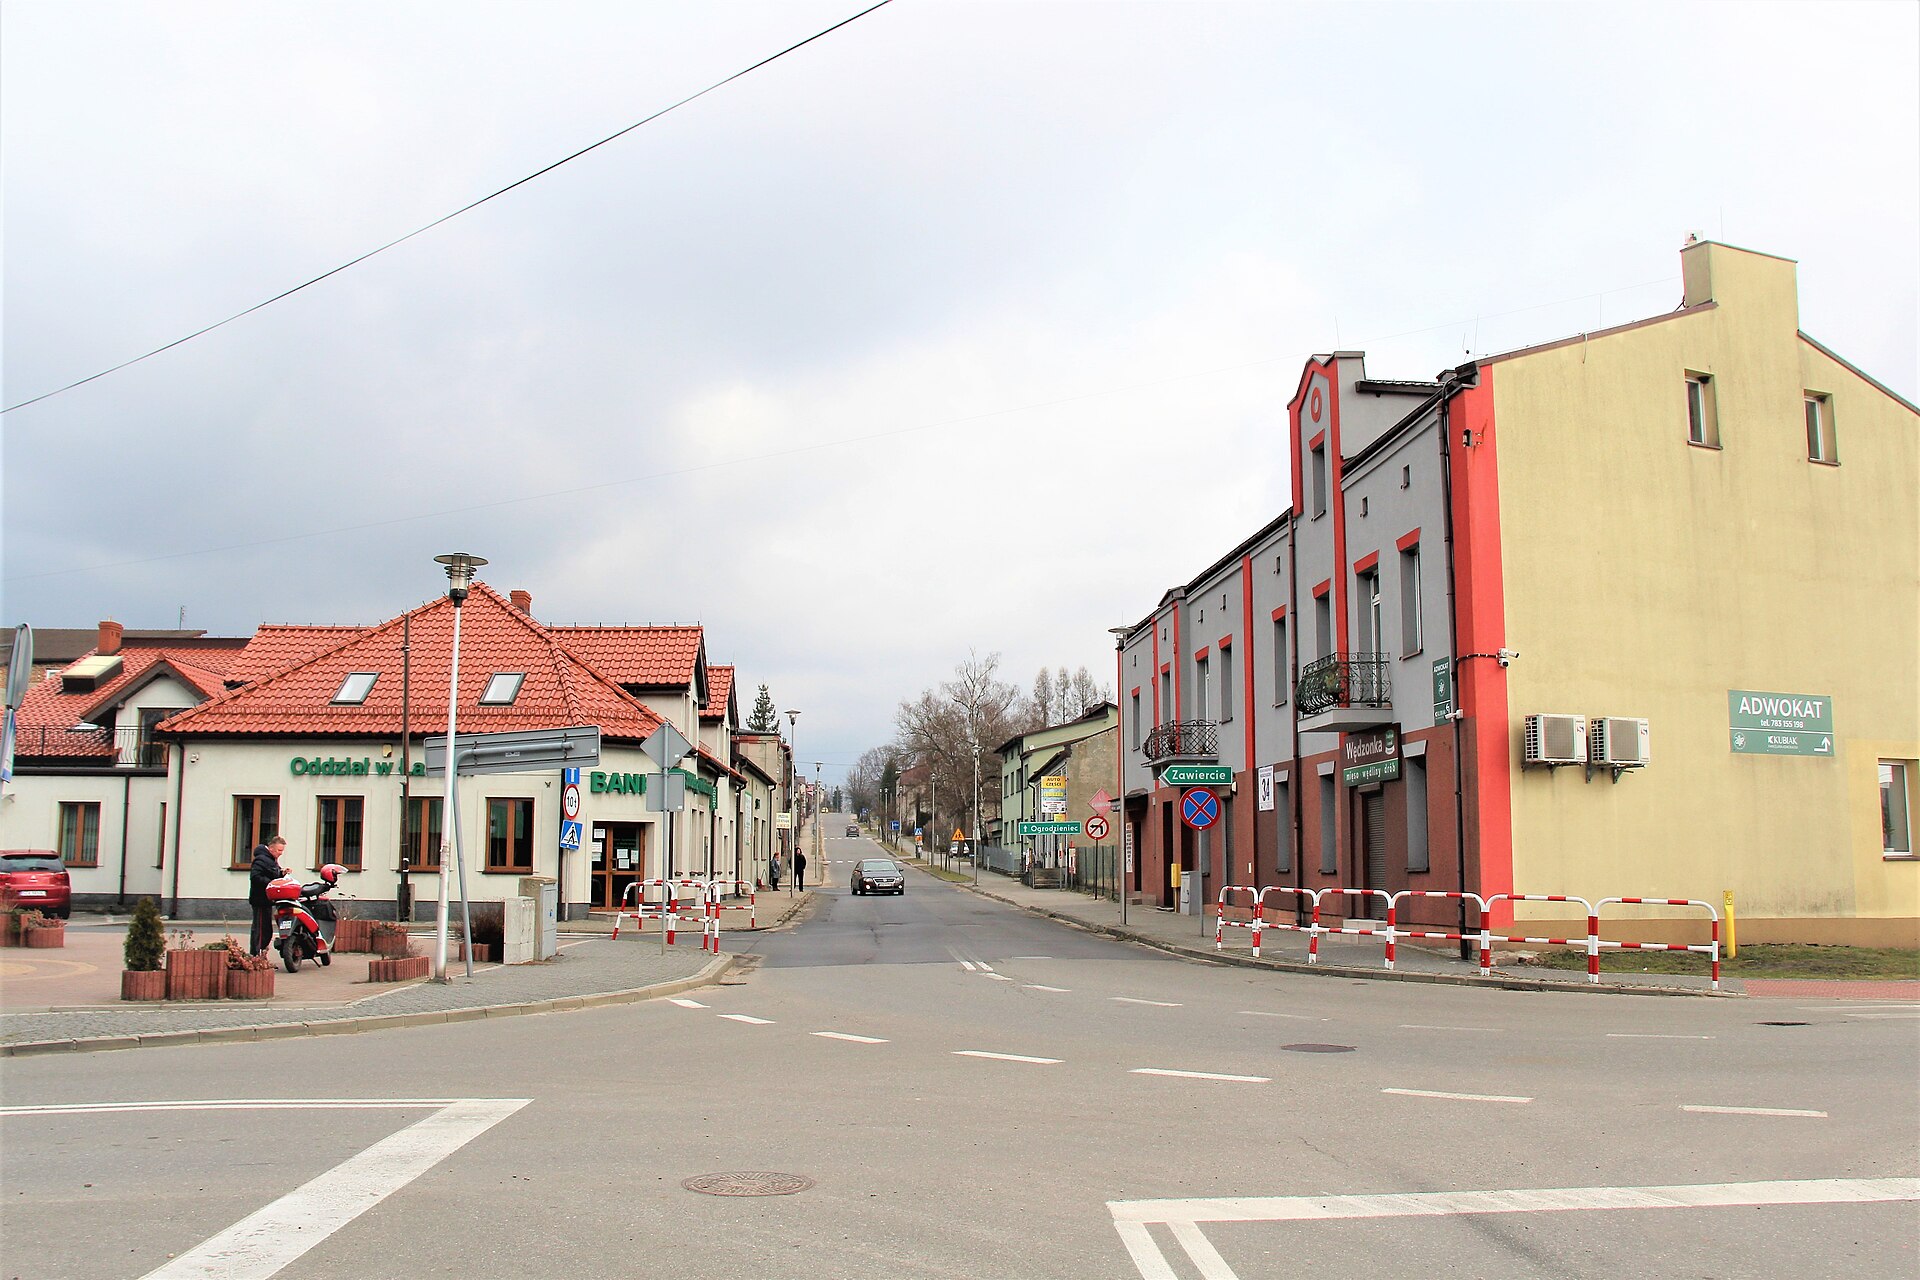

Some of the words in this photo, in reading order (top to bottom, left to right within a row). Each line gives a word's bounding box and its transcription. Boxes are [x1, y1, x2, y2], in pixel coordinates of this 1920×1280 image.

[1738, 697, 1823, 719] ADWOKAT
[1771, 719, 1782, 727] 783
[1783, 720, 1793, 728] 155
[1346, 735, 1383, 763] Wędzonka
[290, 757, 370, 776] Oddział
[375, 761, 394, 776] w
[1171, 769, 1226, 780] Zawiercie
[1261, 777, 1270, 802] 34
[1030, 825, 1078, 834] Ogrodzieniec
